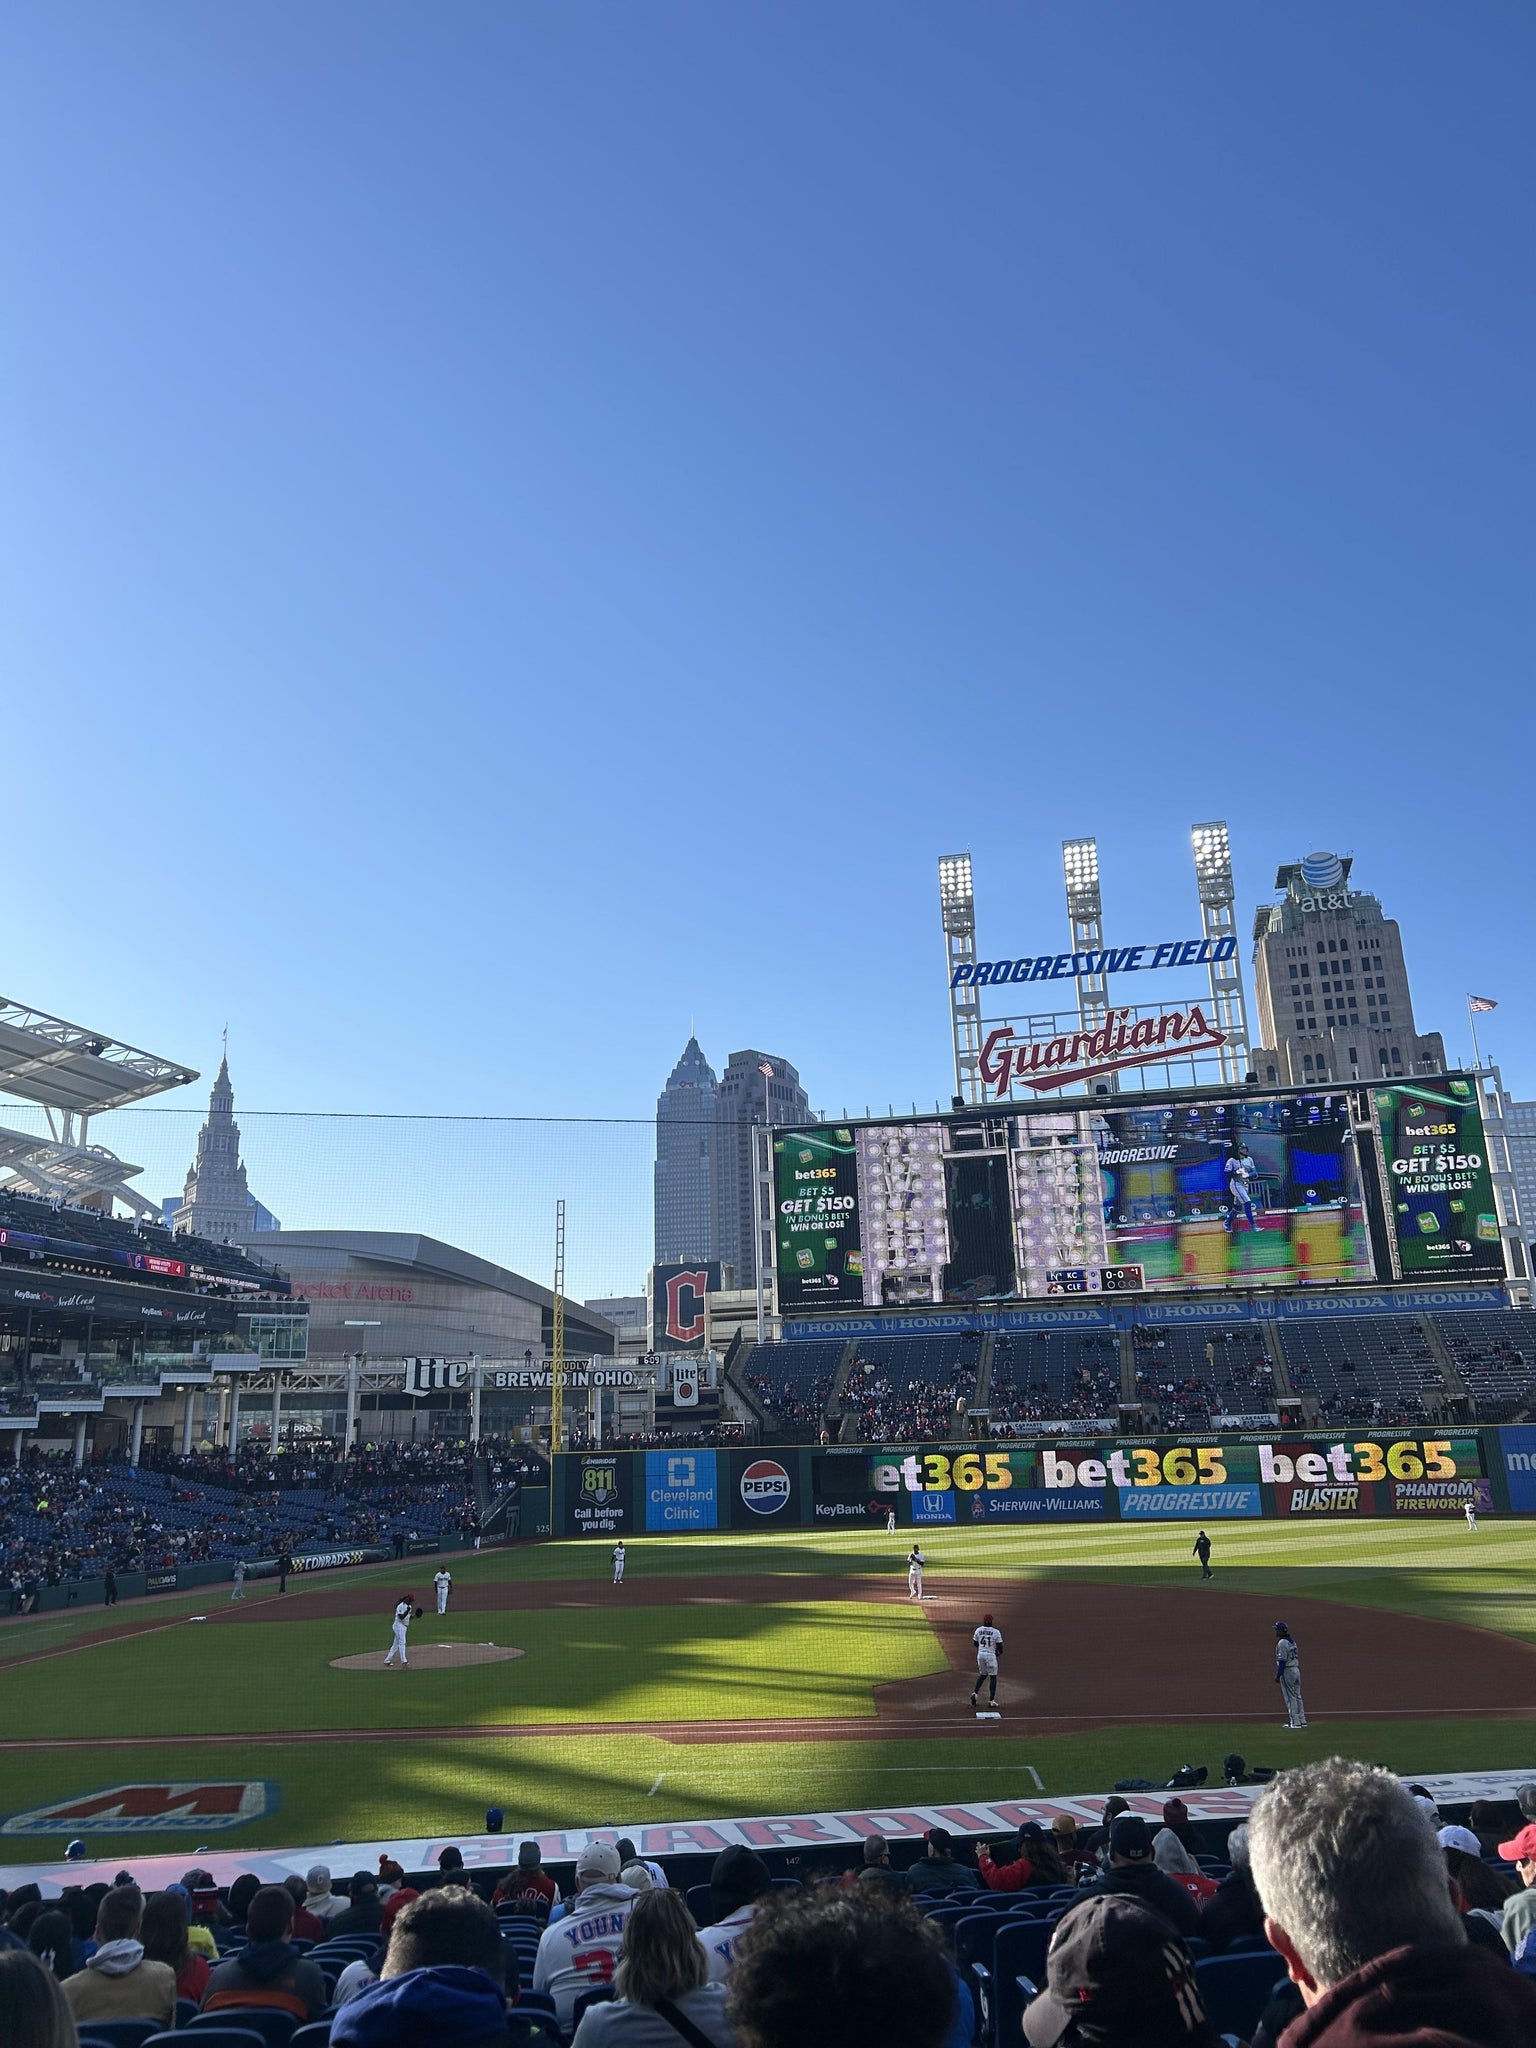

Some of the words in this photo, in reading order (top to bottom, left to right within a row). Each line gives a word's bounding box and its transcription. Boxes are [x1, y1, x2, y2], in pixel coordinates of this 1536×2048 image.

[1300, 890, 1353, 912] at&t
[950, 945, 1146, 988] PROGRESSIVE
[1151, 937, 1237, 970] FIELD
[977, 1005, 1229, 1099] Guardians
[1405, 1124, 1456, 1135] bet365
[1098, 1145, 1178, 1165] PROGRESSIVE
[1413, 1145, 1435, 1154] BET
[1440, 1143, 1456, 1154] $5
[1392, 1157, 1430, 1174] GET
[1436, 1154, 1481, 1172] $150
[795, 1168, 836, 1180] bet365
[1400, 1176, 1411, 1185] IN
[1415, 1174, 1452, 1183] BONUS
[1455, 1172, 1477, 1181] BETS
[799, 1187, 818, 1196] BET
[821, 1186, 835, 1196] $5
[1406, 1184, 1429, 1193] WIN
[1431, 1183, 1446, 1191] OR
[1448, 1181, 1472, 1190] LOSE
[780, 1199, 813, 1214] GET
[817, 1196, 854, 1213] $150
[798, 1214, 829, 1223] BONUS
[831, 1213, 850, 1221] BETS
[790, 1223, 809, 1232] WIN
[811, 1222, 823, 1230] OR
[825, 1221, 844, 1229] LOSE
[176, 1265, 181, 1274] 4
[1106, 1271, 1124, 1279] 0-0
[291, 1281, 352, 1298] ocket
[356, 1282, 415, 1302] Arena
[1067, 1283, 1081, 1291] CLE
[15, 1290, 40, 1300] KeyBank
[1413, 1290, 1497, 1304] HONDA
[666, 1271, 708, 1343] C
[1165, 1303, 1243, 1317] HONDA
[1308, 1296, 1388, 1310] HONDA
[142, 1307, 163, 1317] KeyBank
[1027, 1309, 1103, 1323] HONDA
[807, 1319, 877, 1333] HONDA
[899, 1316, 971, 1329] HONDA
[402, 1356, 468, 1397] Lite
[496, 1372, 568, 1387] BREWED
[572, 1372, 589, 1386] IN
[593, 1371, 634, 1386] OHIO
[675, 1368, 696, 1382] Lite
[1240, 1434, 1282, 1442] PROGRESSIVE
[1303, 1432, 1346, 1440] PROGRESSIVE
[1367, 1430, 1411, 1438] PROGRESSIVE
[1434, 1428, 1479, 1436] PROGRESSIVE
[1056, 1440, 1096, 1448] PROGRESSIVE
[1116, 1438, 1158, 1446] PROGRESSIVE
[1177, 1436, 1218, 1444] PROGRESSIVE
[1042, 1448, 1227, 1488] bet365
[1258, 1441, 1457, 1483] bet365
[584, 1469, 613, 1491] 811
[743, 1480, 788, 1494] PEPSI
[651, 1488, 713, 1503] Cleveland
[1395, 1482, 1473, 1497] PHANTOM
[1123, 1491, 1252, 1512] PROGRESSIVE
[1291, 1488, 1358, 1511] BLASTER
[574, 1508, 591, 1518] Call
[594, 1507, 624, 1518] before
[664, 1506, 700, 1520] Clinic
[815, 1503, 866, 1517] KeyBank
[535, 1525, 550, 1533] 325
[582, 1520, 599, 1532] you
[599, 1519, 616, 1531] dig.
[304, 1552, 350, 1571] CONRAD'S
[980, 1636, 991, 1647] 41
[20, 1814, 235, 1830] Marathon
[564, 1912, 630, 1948] YOUN
